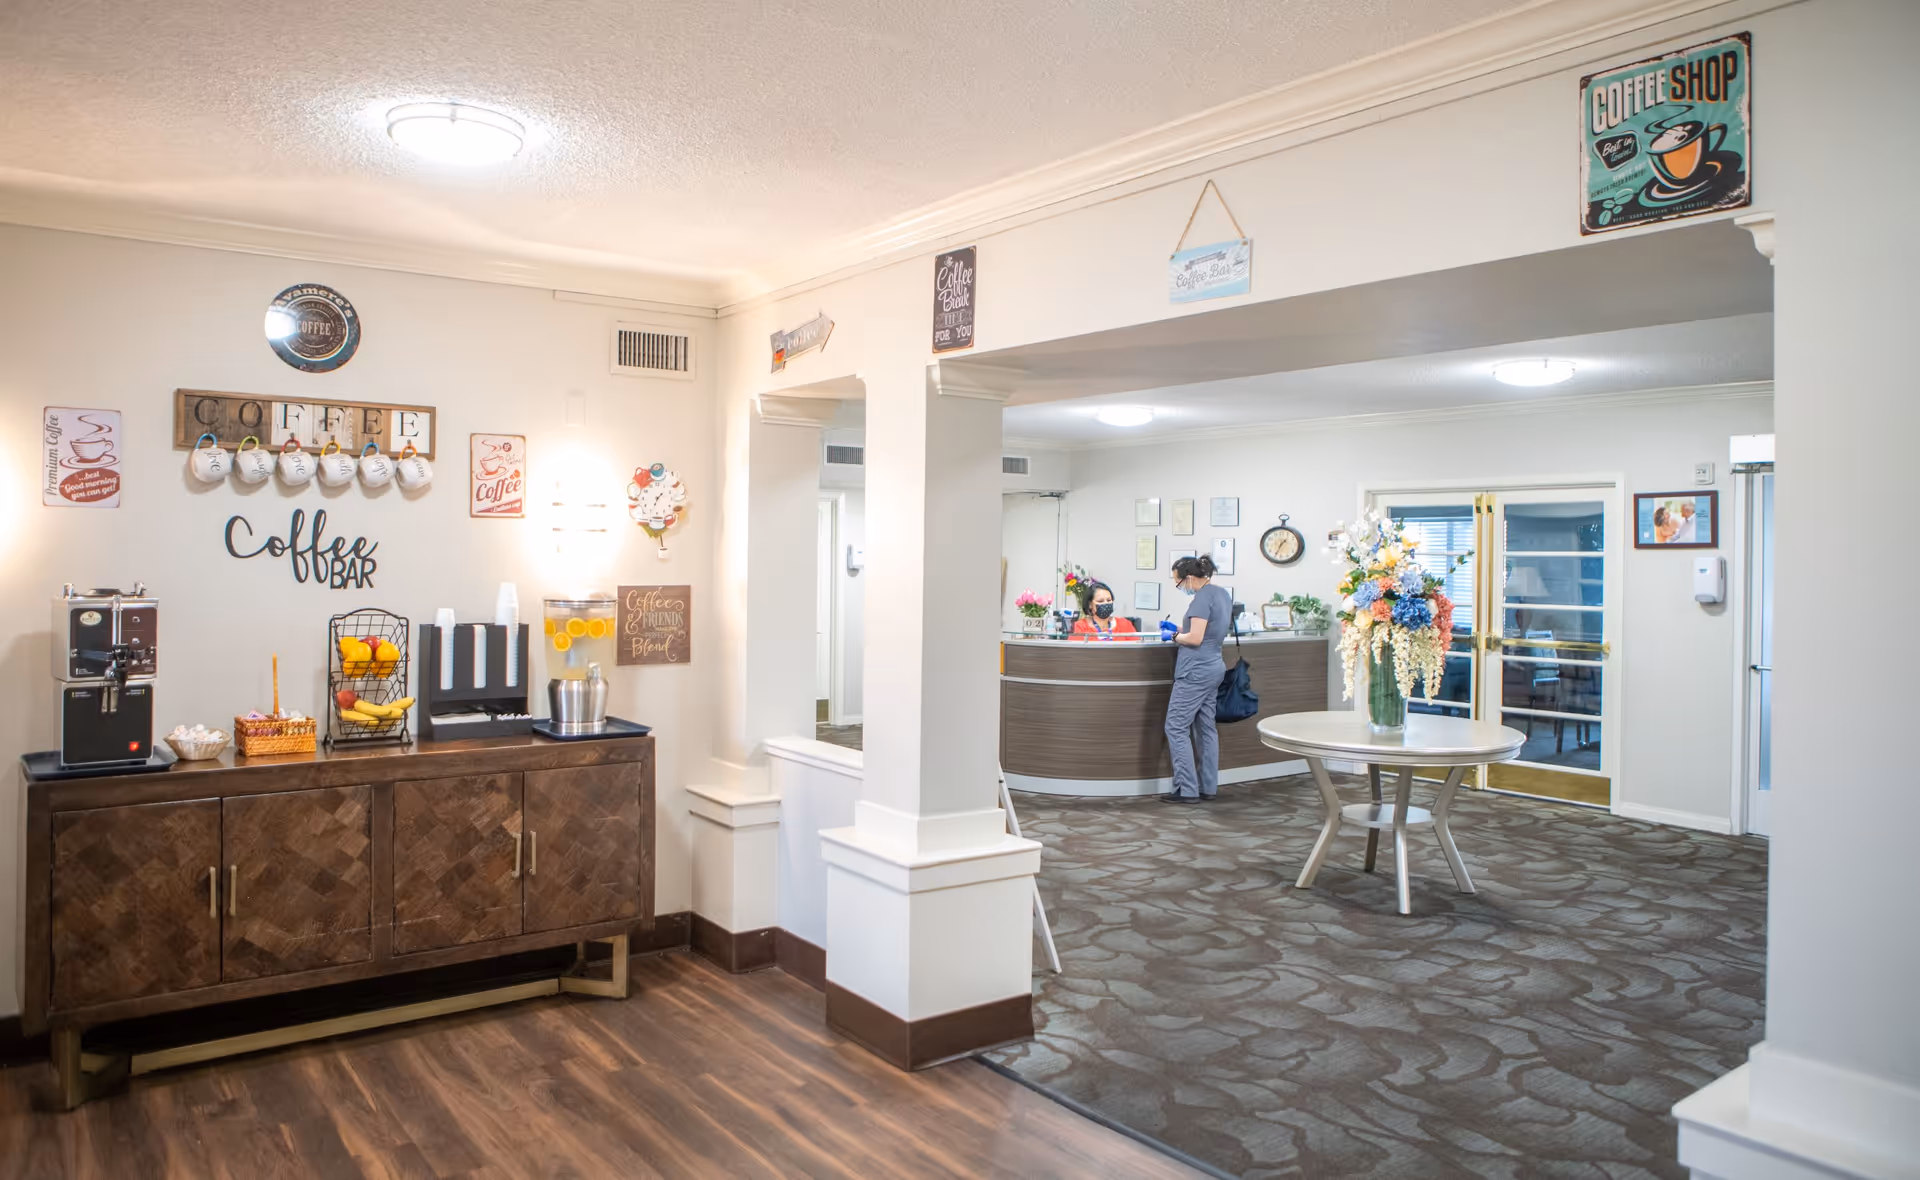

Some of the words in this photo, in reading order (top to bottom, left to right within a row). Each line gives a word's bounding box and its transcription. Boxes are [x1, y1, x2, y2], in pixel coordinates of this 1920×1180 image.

[1592, 68, 1667, 136] COFFEE
[1669, 50, 1738, 103] SHOP
[1602, 138, 1623, 157] Best
[937, 260, 973, 298] Coffee
[1176, 269, 1207, 290] Coffee
[1209, 264, 1232, 279] Bar
[938, 287, 970, 312] Break
[296, 320, 331, 336] COFFEE
[935, 329, 951, 342] FOR
[956, 325, 972, 338] YOU
[46, 415, 62, 446] Coffee
[194, 398, 420, 437] COFFEE
[45, 448, 58, 496] Premium
[476, 478, 522, 503] Coffee
[225, 508, 379, 584] Coffee
[330, 557, 377, 590] BAR
[626, 586, 685, 611] Coffee
[642, 611, 684, 629] FRIENDS
[631, 634, 678, 662] Blend
